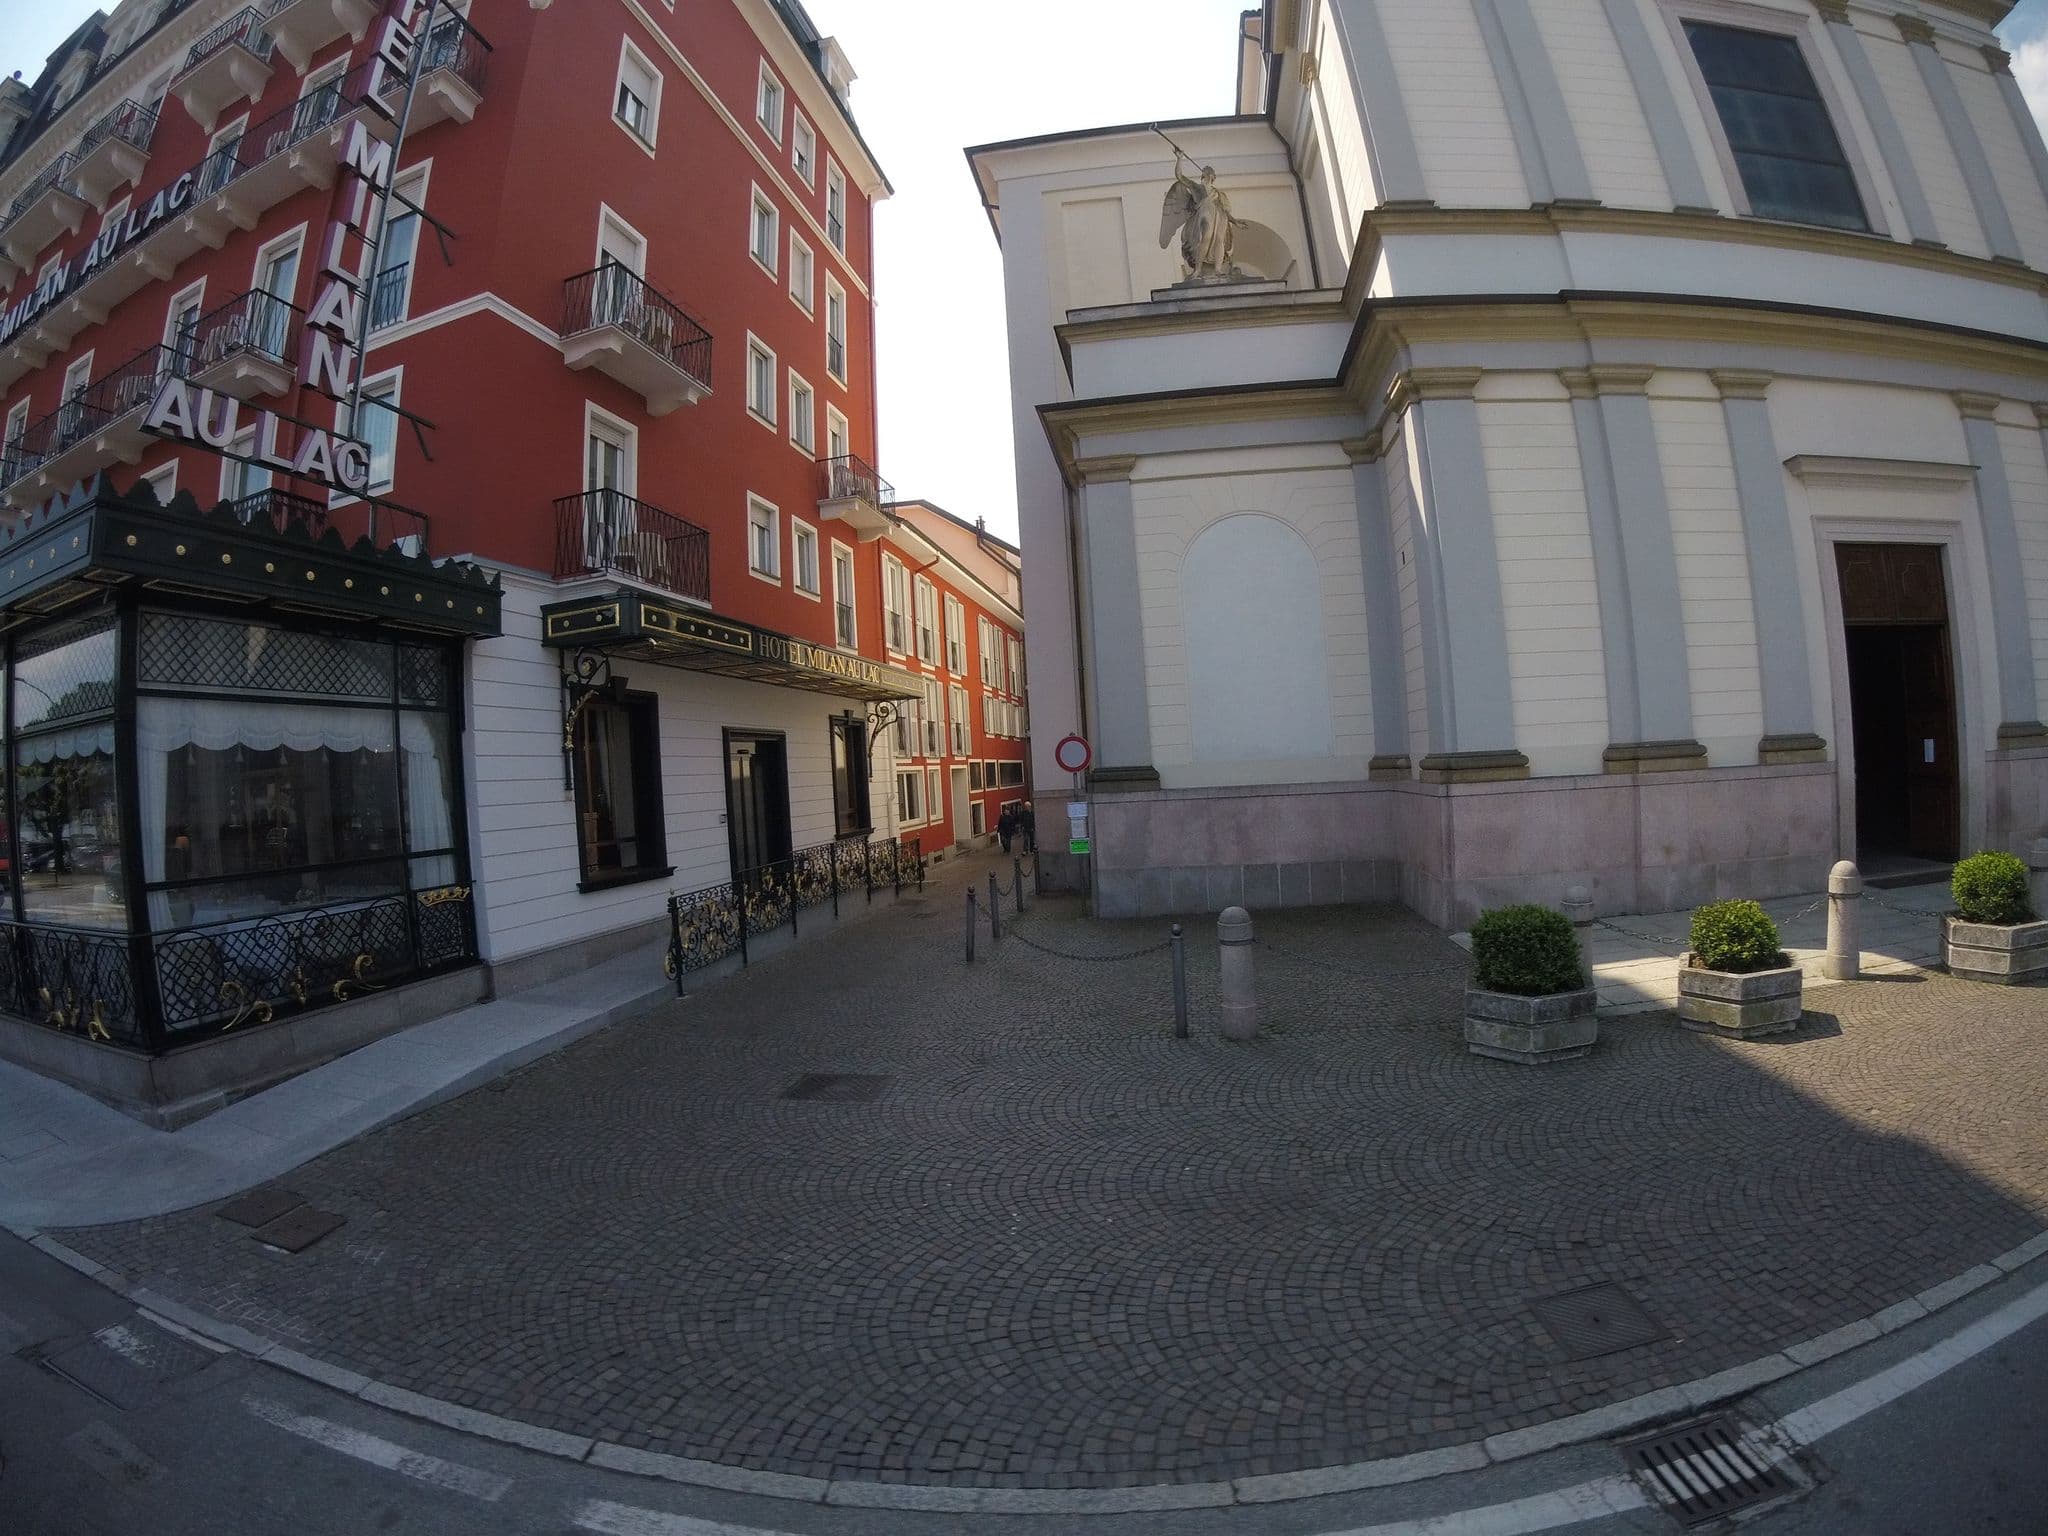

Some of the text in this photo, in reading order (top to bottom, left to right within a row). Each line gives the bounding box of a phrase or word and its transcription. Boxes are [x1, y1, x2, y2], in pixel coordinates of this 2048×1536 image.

[0, 260, 71, 343] MILAN
[308, 119, 392, 399] MILAN
[150, 376, 370, 490] AU LAC
[759, 634, 805, 665] HOTEL
[807, 648, 845, 674] MILAN
